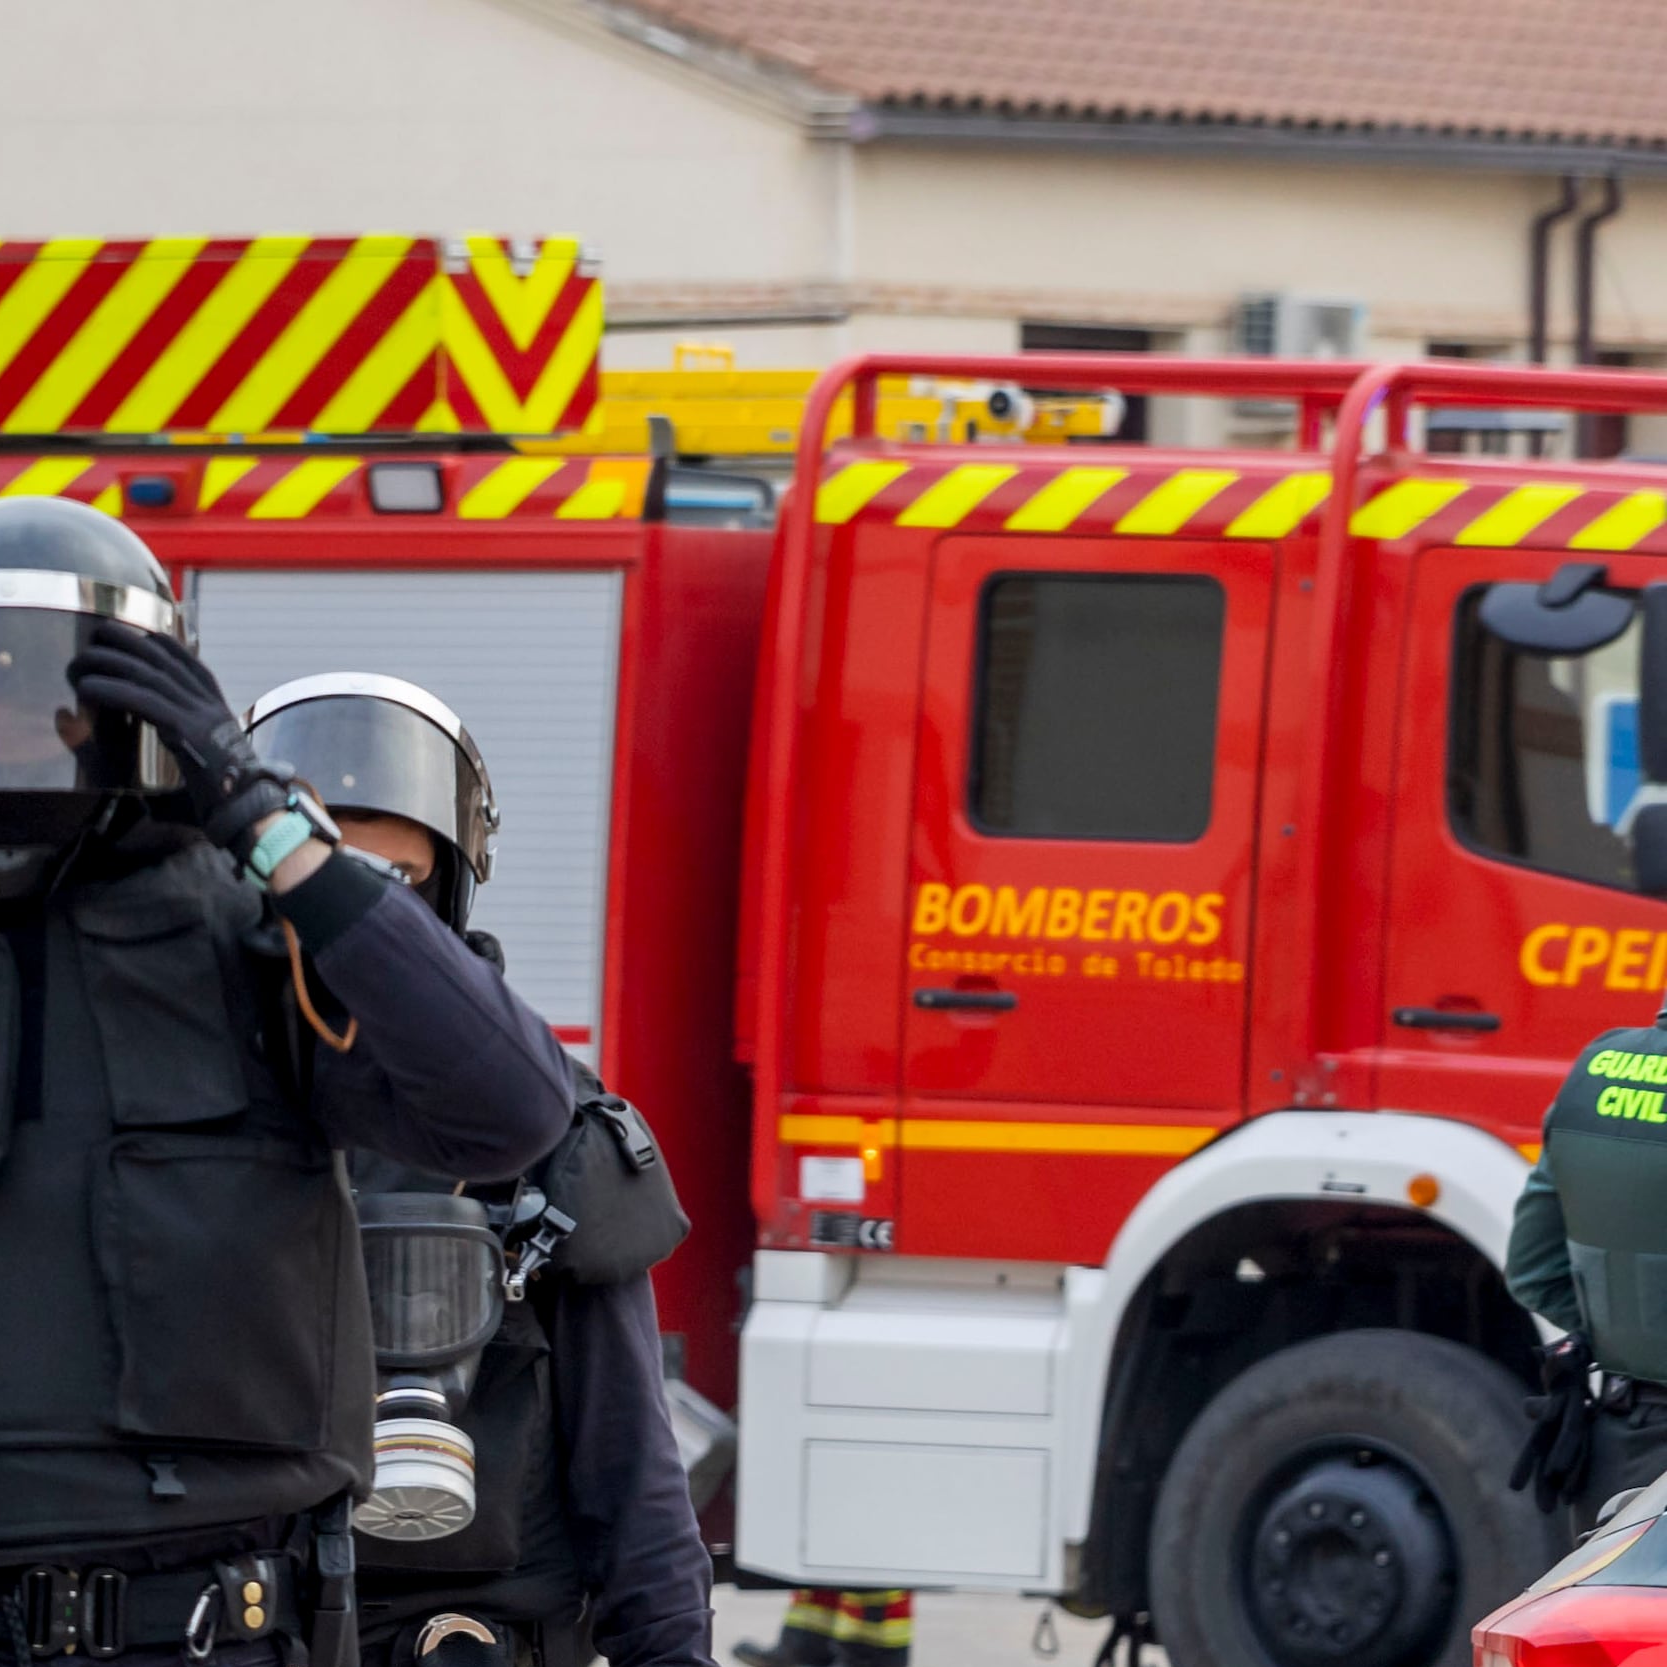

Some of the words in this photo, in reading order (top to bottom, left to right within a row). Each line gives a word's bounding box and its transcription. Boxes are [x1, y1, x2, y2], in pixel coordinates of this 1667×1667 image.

[912, 882, 1225, 946] BOMBEROS
[909, 943, 1066, 976] Consorcio
[1081, 951, 1118, 978] de
[1134, 950, 1244, 983] Toledo
[1596, 1086, 1667, 1123] CIVIL
